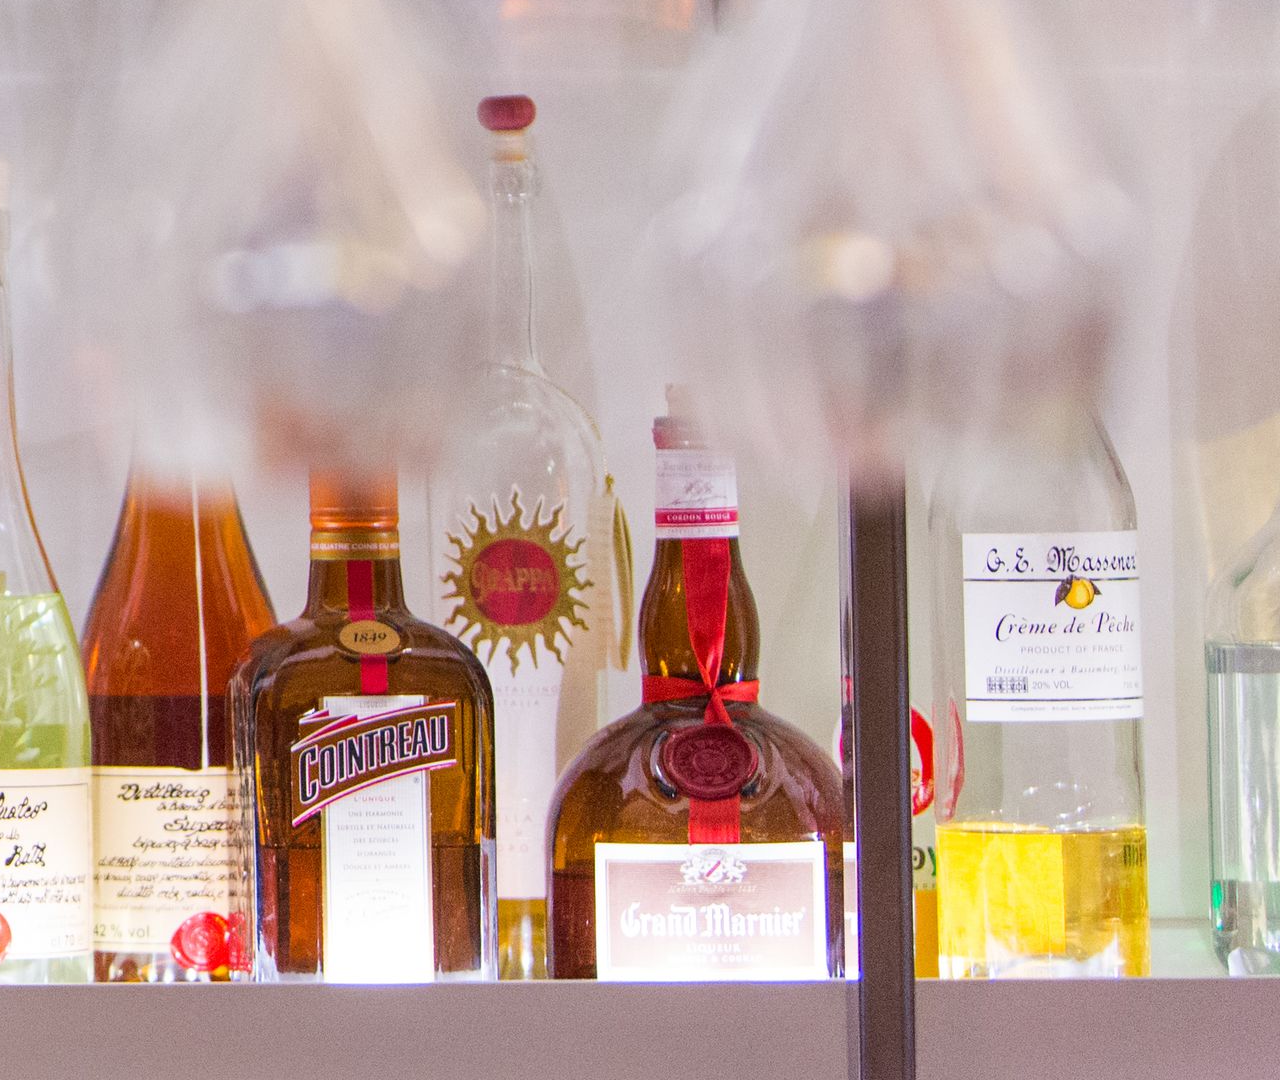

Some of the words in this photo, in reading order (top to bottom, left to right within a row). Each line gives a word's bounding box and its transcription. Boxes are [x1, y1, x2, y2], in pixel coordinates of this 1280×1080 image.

[353, 631, 387, 642] 1849
[995, 613, 1058, 641] Crème
[1063, 617, 1086, 634] de
[299, 715, 449, 805] COINTREAU
[93, 924, 105, 936] 42
[620, 901, 698, 938] Grand
[699, 902, 807, 938] Marnier
